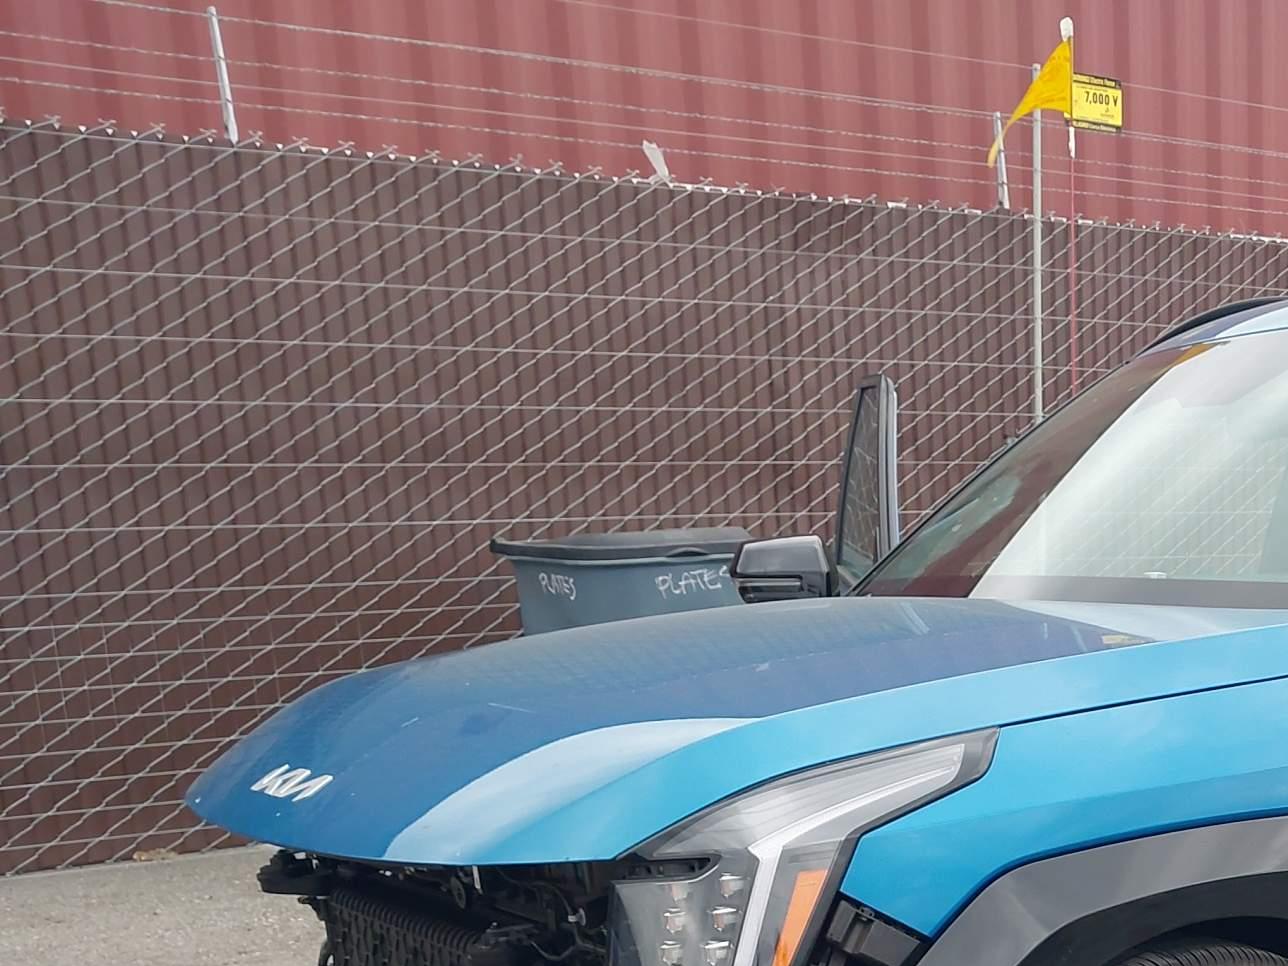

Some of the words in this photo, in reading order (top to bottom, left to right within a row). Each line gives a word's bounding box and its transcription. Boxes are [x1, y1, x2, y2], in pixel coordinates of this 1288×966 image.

[1084, 91, 1110, 106] 7,000
[1112, 95, 1119, 107] V
[538, 572, 577, 601] PLATES
